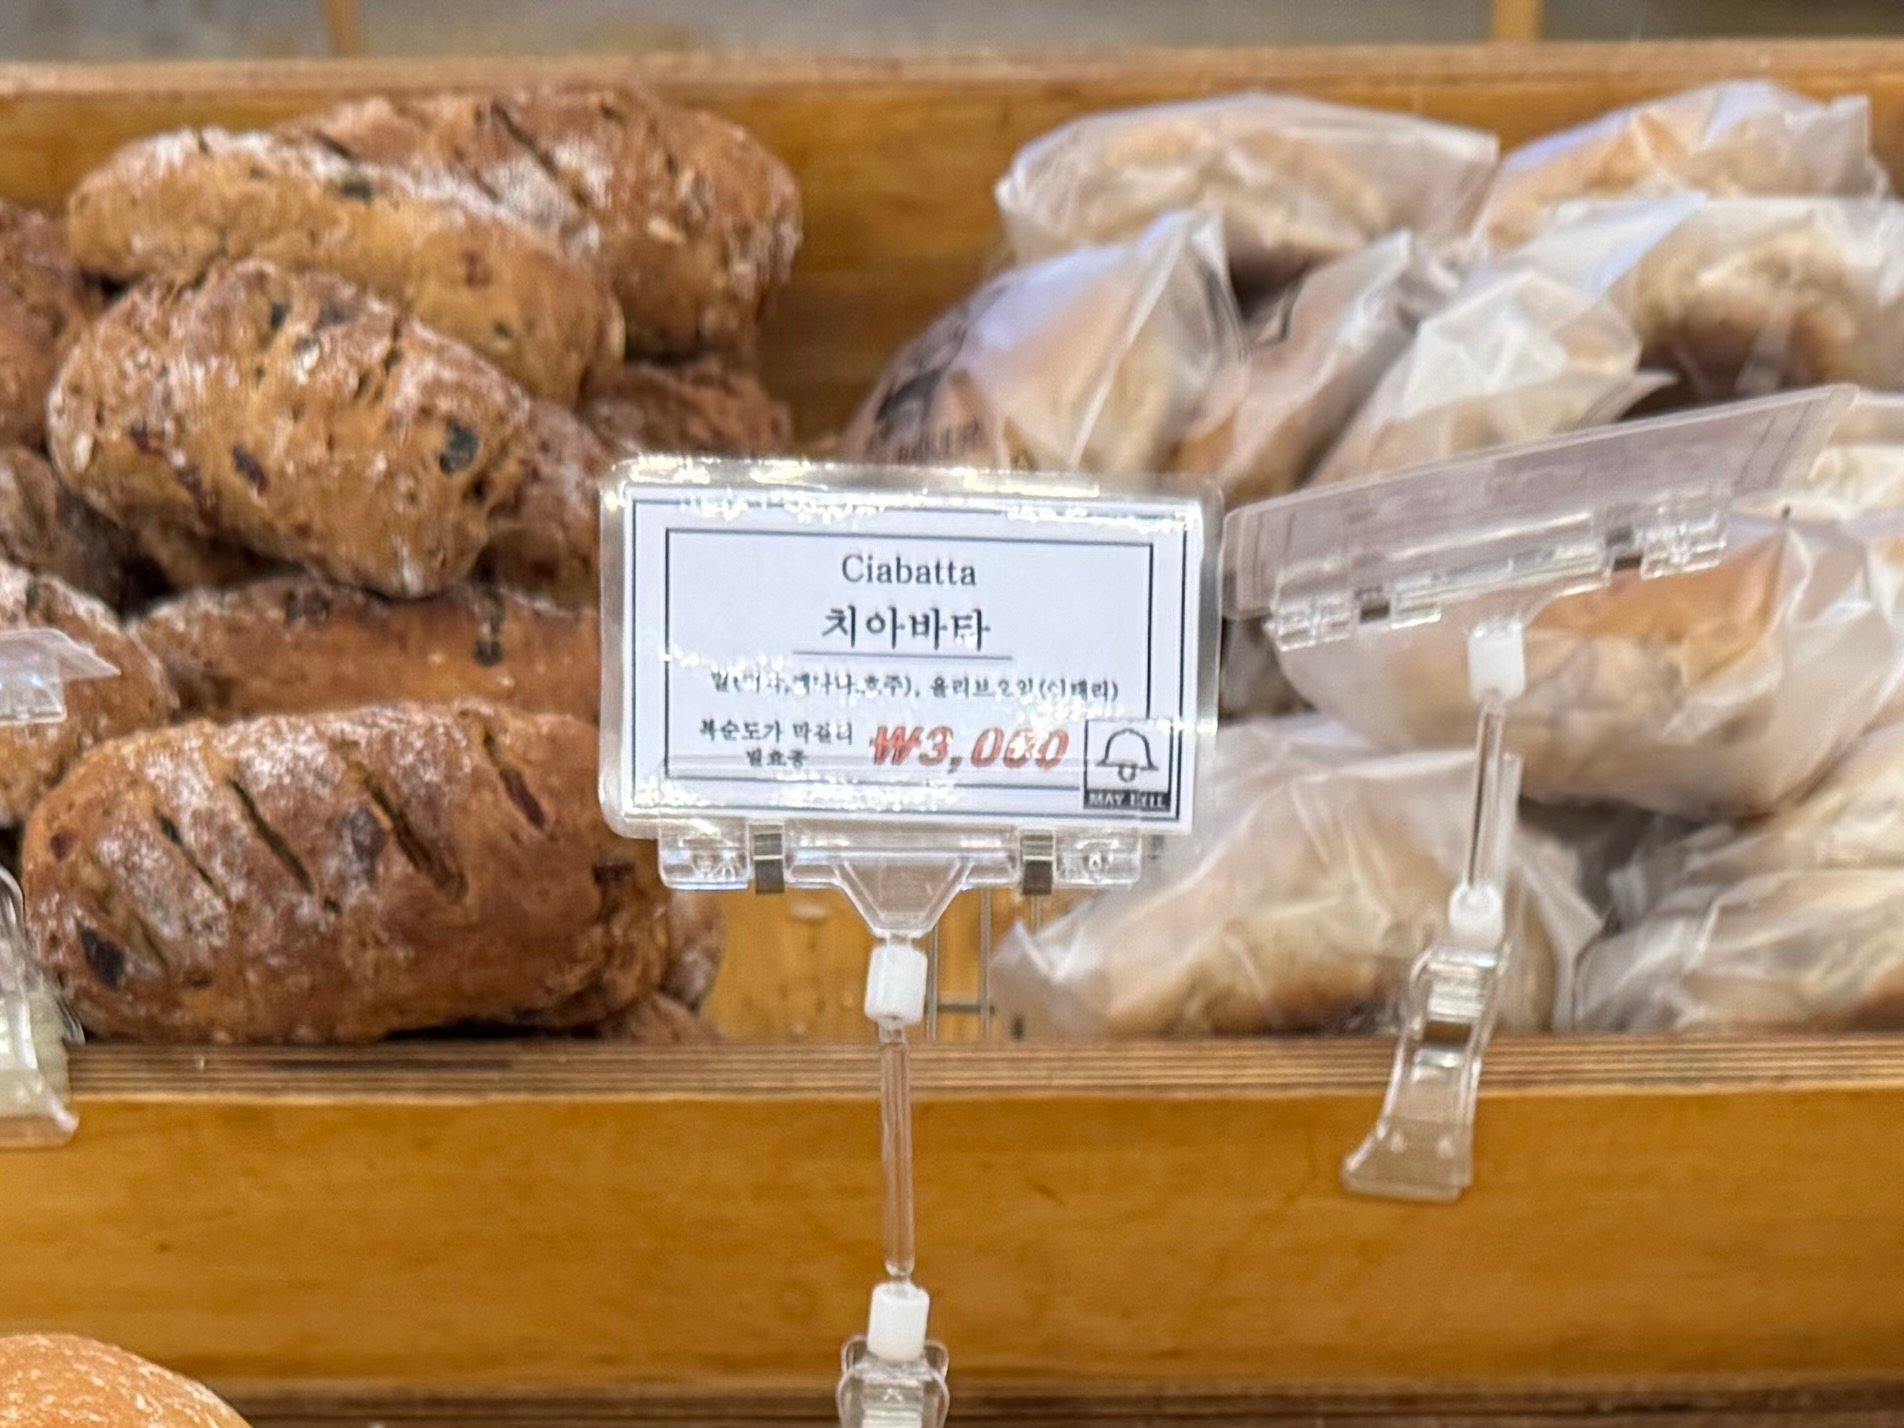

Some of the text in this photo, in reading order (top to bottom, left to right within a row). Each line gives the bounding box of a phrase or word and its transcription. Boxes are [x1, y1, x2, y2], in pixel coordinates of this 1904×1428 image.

[841, 553, 977, 586] Ciabatta
[821, 604, 991, 652] 치아바타
[792, 719, 854, 745] 막걸리
[1088, 791, 1125, 807] MAY
